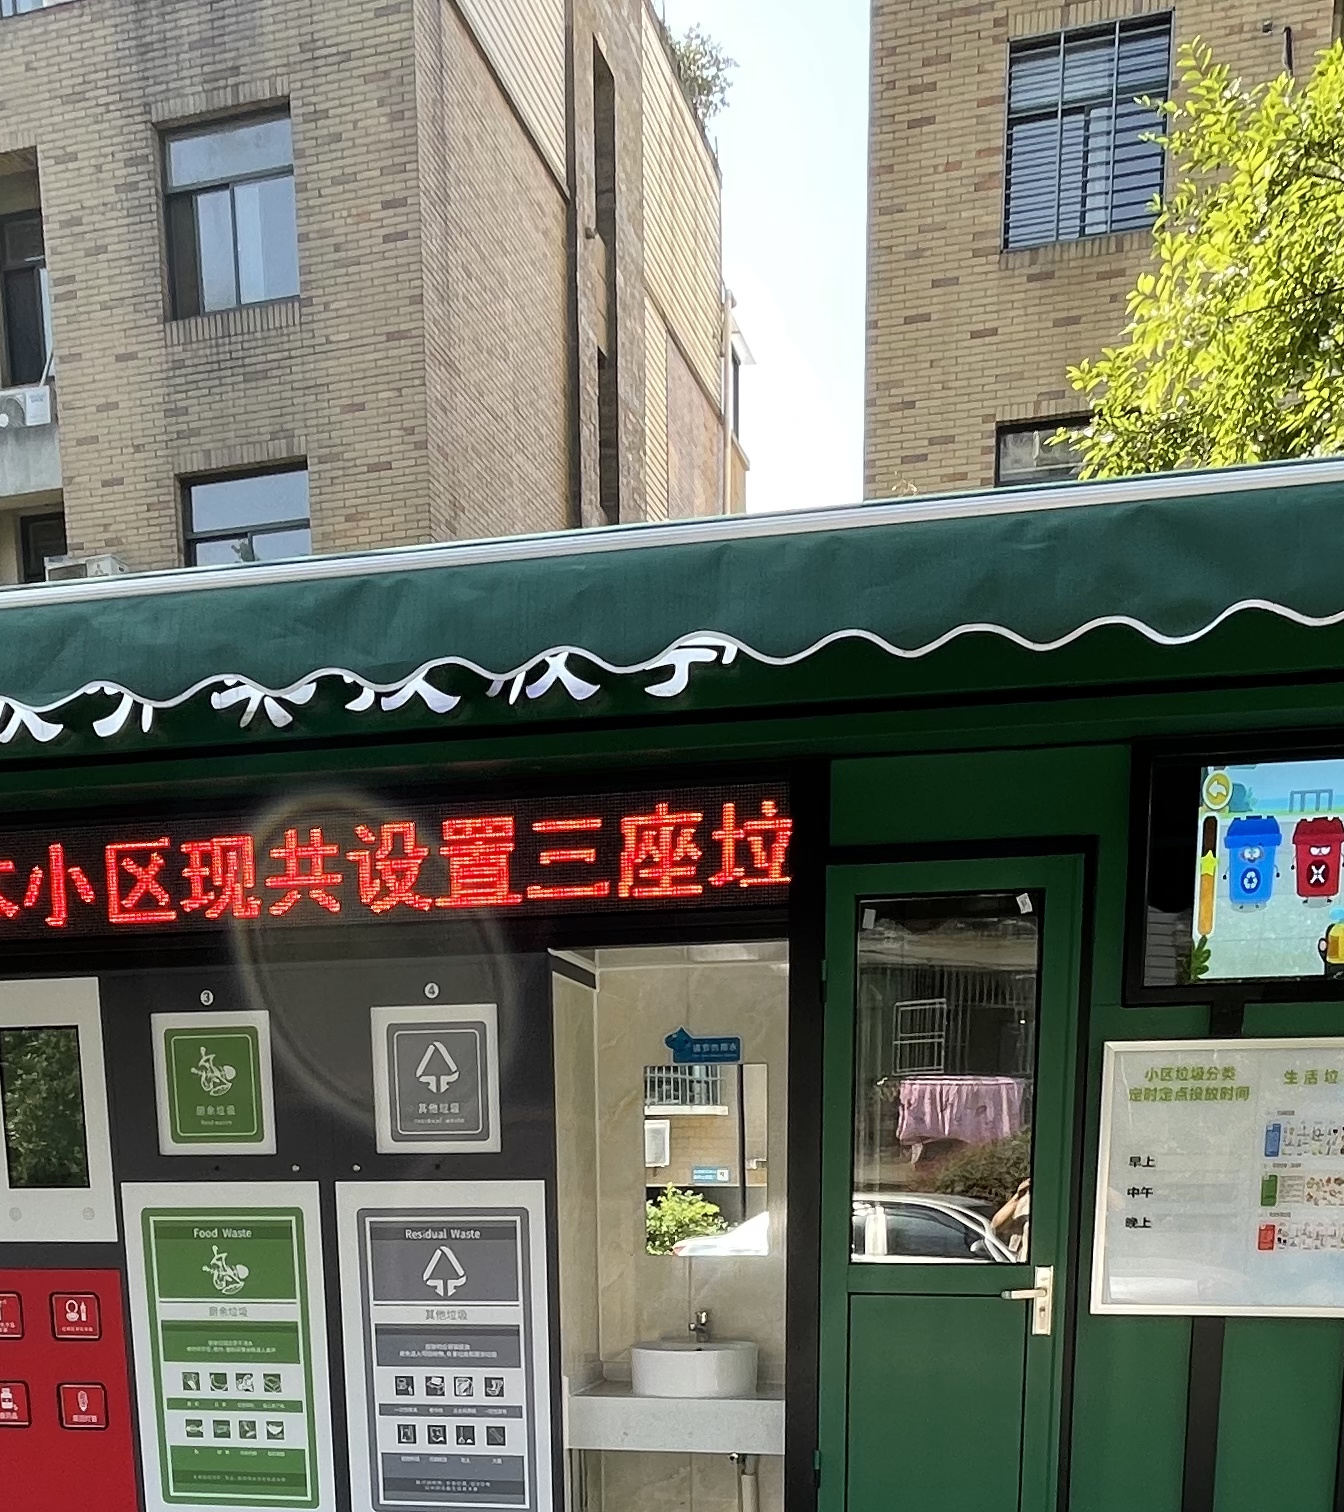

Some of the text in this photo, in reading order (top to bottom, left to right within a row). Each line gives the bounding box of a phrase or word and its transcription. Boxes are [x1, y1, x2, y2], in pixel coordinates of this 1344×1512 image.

[1144, 1066, 1236, 1082] 小区垃圾分类
[1128, 1086, 1251, 1102] 定时定点投放时间
[418, 1102, 460, 1115] 其他垃圾
[1129, 1154, 1155, 1168] 早上
[1127, 1186, 1154, 1199] 中午
[193, 1228, 252, 1239] Food Waste
[405, 1228, 481, 1240] Residual Waste
[425, 1309, 469, 1321] 其他垃圾
